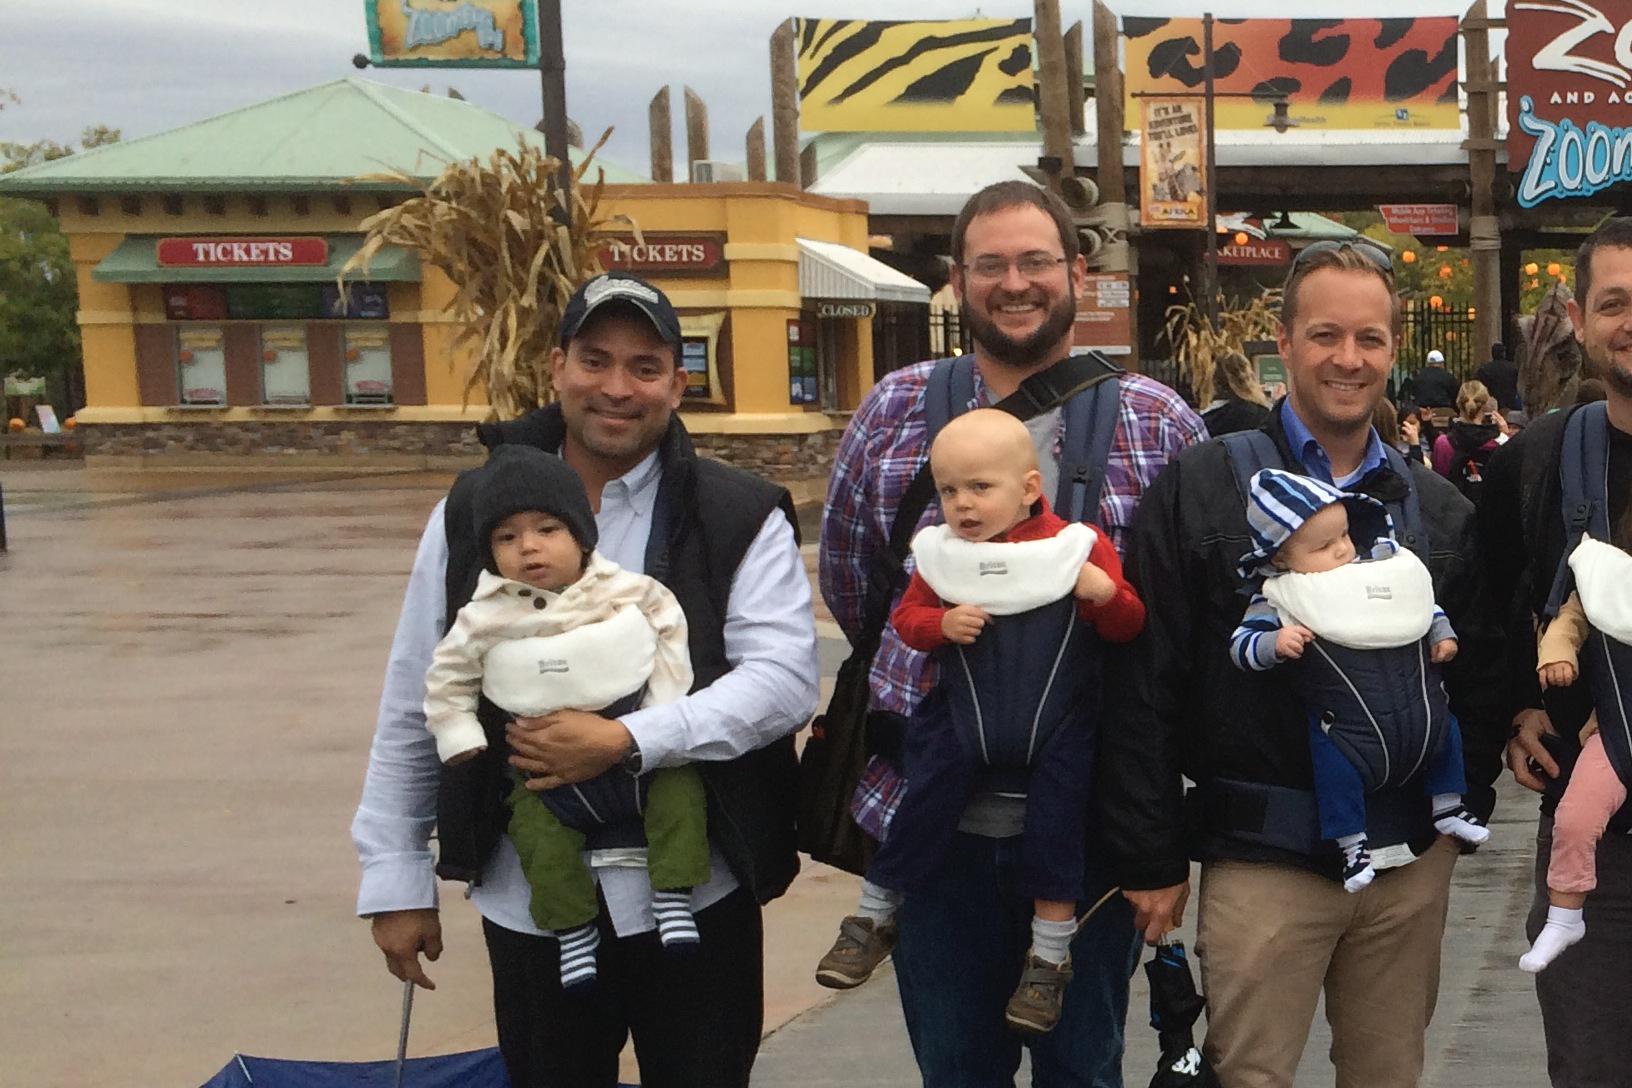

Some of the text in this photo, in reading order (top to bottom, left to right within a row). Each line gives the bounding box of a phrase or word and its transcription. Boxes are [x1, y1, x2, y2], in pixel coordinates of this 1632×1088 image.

[1550, 91, 1596, 104] AND
[192, 242, 293, 262] TICKETS
[609, 244, 705, 262] TCKETS
[1217, 245, 1282, 259] KETPLACE
[821, 304, 870, 316] CLOSED
